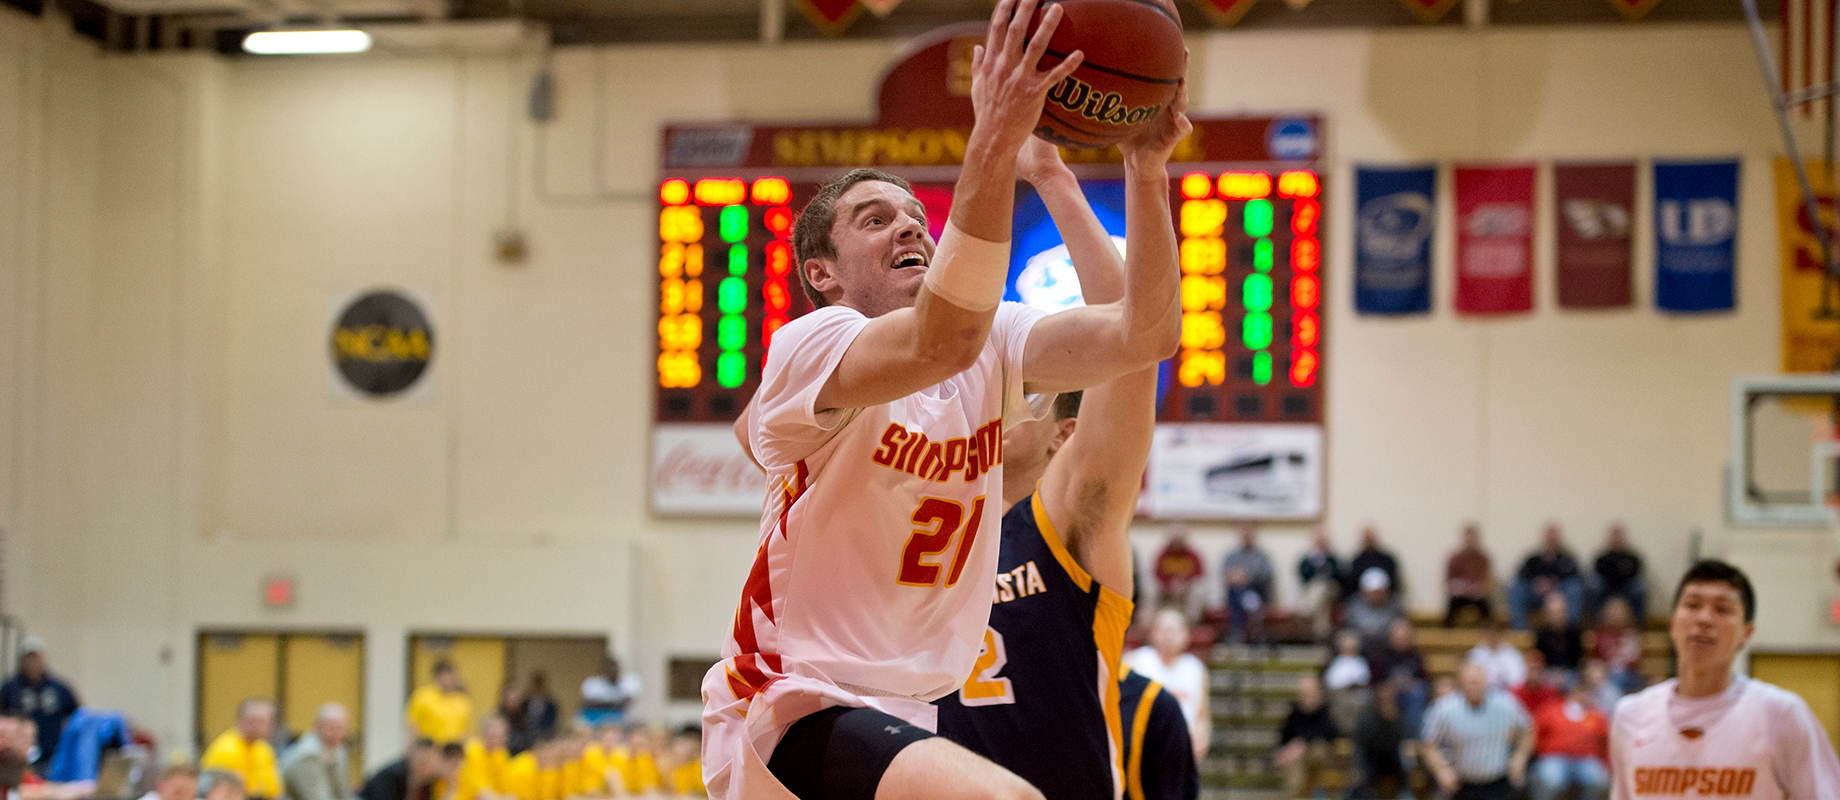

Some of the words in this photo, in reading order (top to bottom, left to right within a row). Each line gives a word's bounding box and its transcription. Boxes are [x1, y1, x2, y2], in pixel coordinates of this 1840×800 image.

[1047, 75, 1162, 125] Wilson
[872, 417, 1003, 483] SIMPSON
[896, 495, 986, 589] 21
[1634, 766, 1757, 796] SIMPSON
